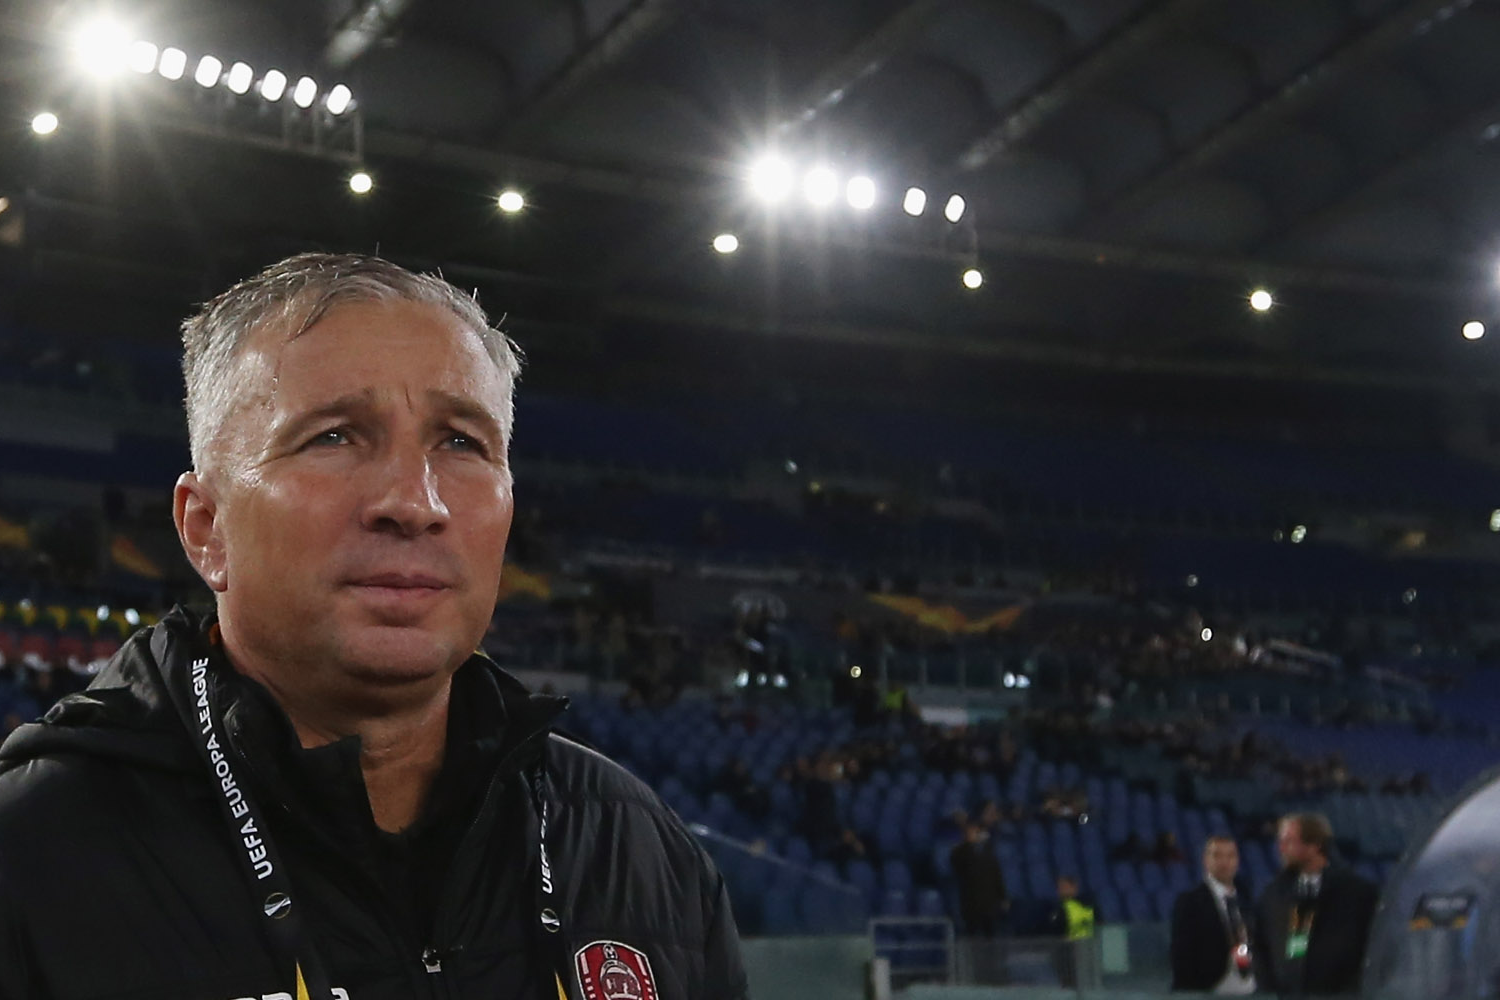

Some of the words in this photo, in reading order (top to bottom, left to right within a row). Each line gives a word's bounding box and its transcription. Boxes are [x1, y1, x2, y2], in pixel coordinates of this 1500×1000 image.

[192, 657, 213, 734] LEAGUE
[206, 733, 249, 819] EUROPA
[240, 818, 273, 880] UEFA
